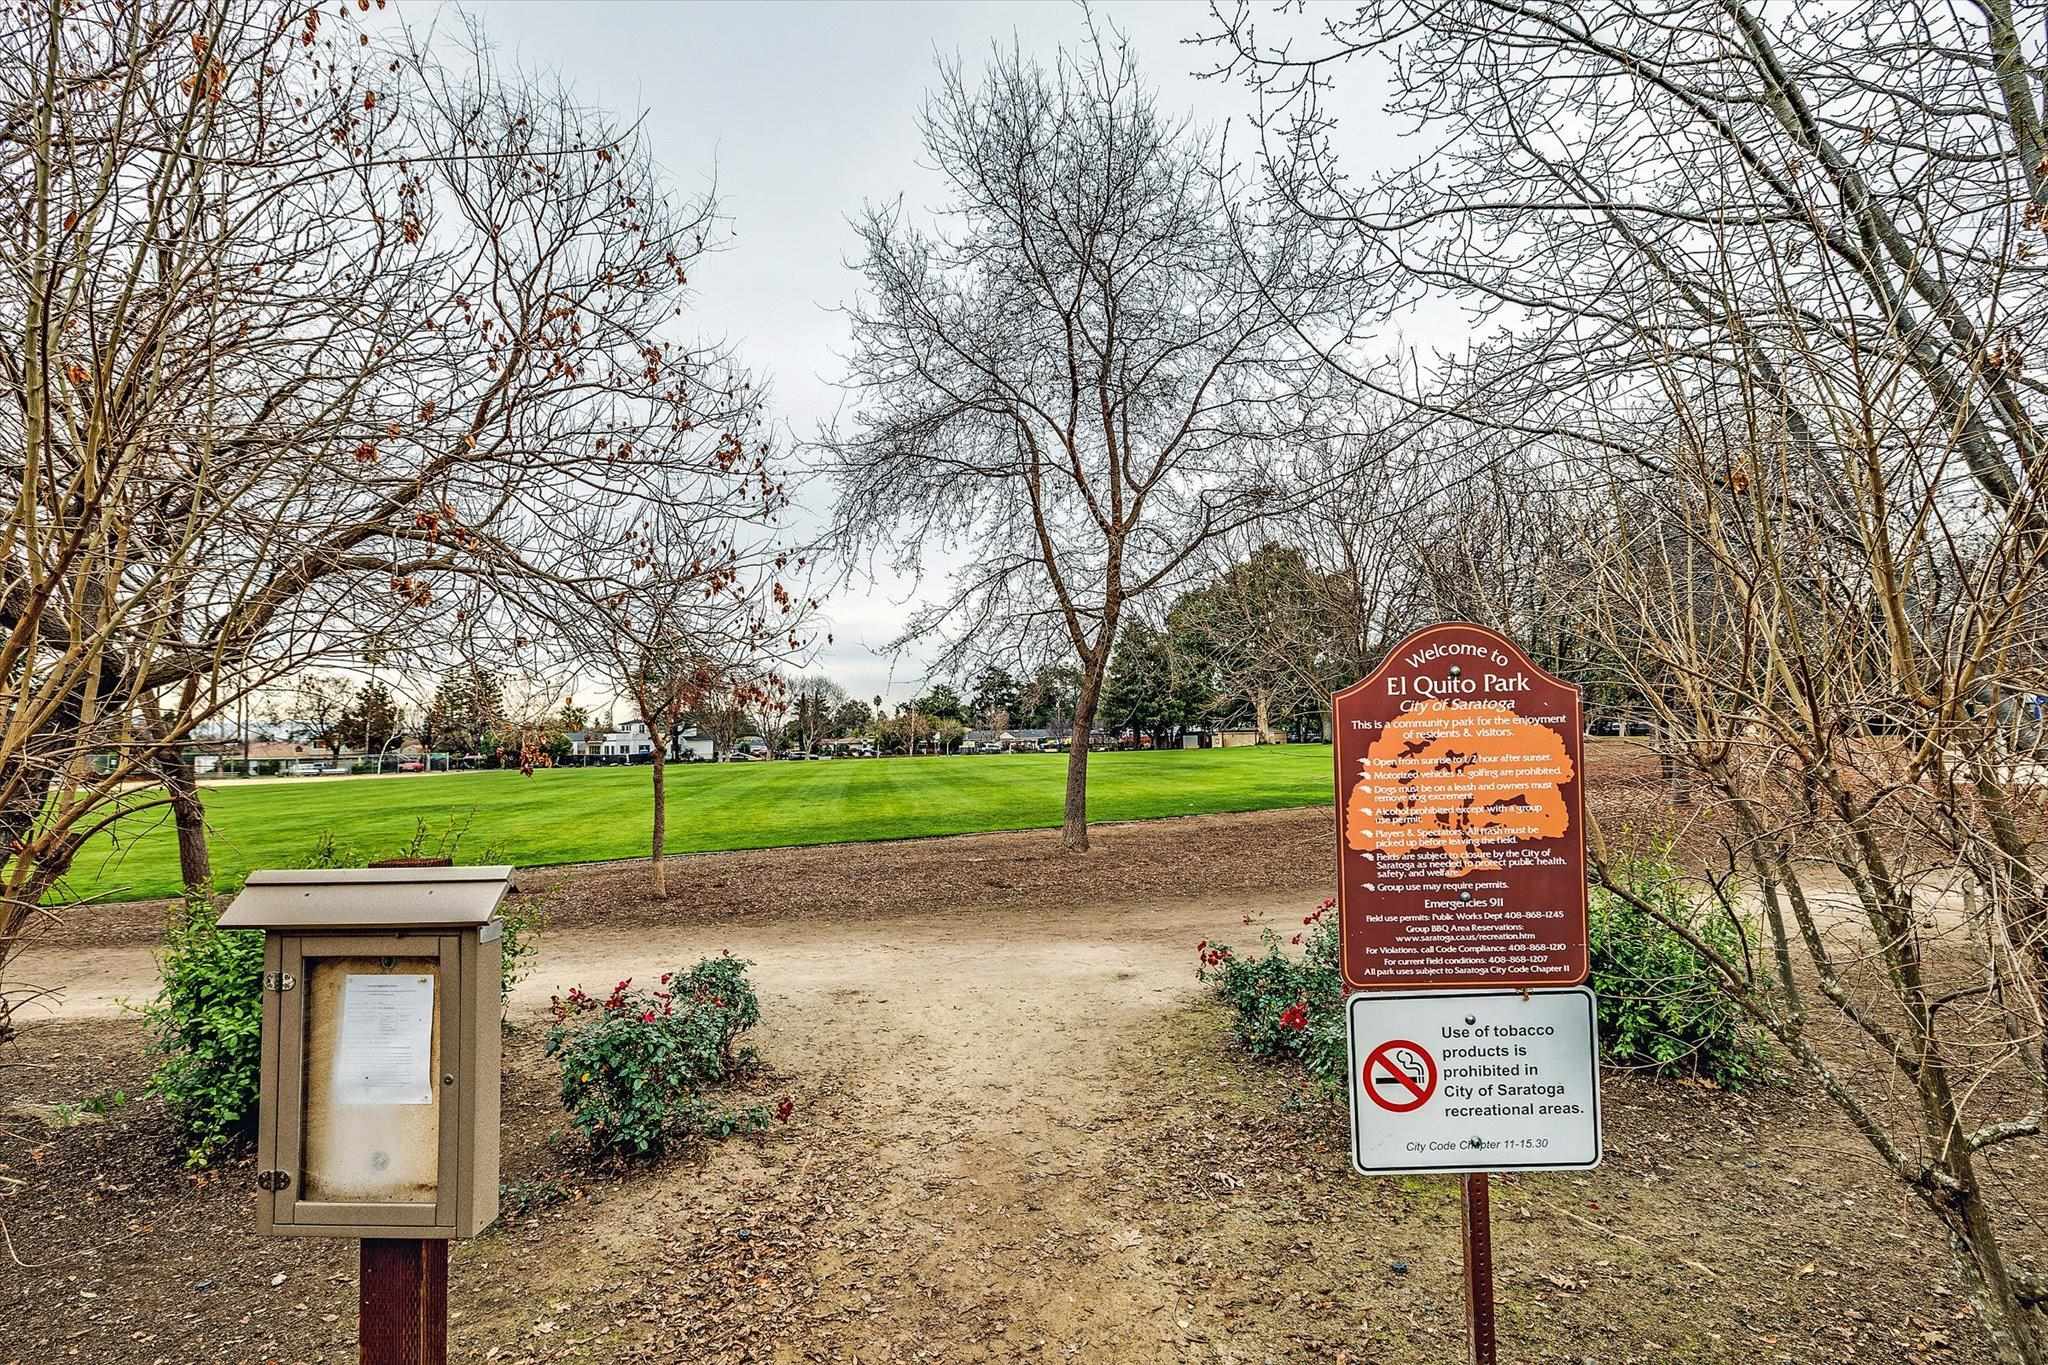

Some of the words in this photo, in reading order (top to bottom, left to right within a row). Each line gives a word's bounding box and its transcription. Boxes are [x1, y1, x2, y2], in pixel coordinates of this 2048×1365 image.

[1405, 643, 1488, 669] Welcome
[1490, 650, 1509, 666] to
[1387, 677, 1406, 696] El
[1414, 677, 1476, 699] Quito
[1484, 673, 1530, 692] Park
[1400, 700, 1426, 713] City
[1432, 699, 1448, 711] of
[1451, 699, 1515, 712] Saratoga
[1352, 721, 1373, 729] This
[1374, 721, 1383, 729] is
[1392, 719, 1450, 730] community
[1452, 719, 1474, 729] park
[1477, 717, 1491, 726] for
[1493, 717, 1510, 726] the
[1513, 715, 1566, 726] enjoyment
[1403, 731, 1414, 740] of
[1416, 729, 1460, 739] residents
[1463, 729, 1471, 738] &
[1373, 758, 1397, 767] Open
[1398, 757, 1420, 765] from
[1422, 757, 1452, 765] sunrise
[1478, 756, 1499, 764] hour
[1500, 755, 1521, 763] after
[1374, 771, 1417, 780] Motorized
[1419, 771, 1455, 779] vehicles
[1457, 770, 1465, 778] &
[1468, 769, 1499, 780] golfing
[1374, 785, 1397, 794] Dogs
[1399, 785, 1418, 793] must
[1420, 784, 1431, 792] be
[1454, 783, 1476, 791] leash
[1478, 782, 1495, 790] and
[1375, 794, 1409, 802] remove
[1410, 793, 1427, 803] dog
[1376, 807, 1408, 815] Alcohol
[1410, 806, 1454, 816] prohibited
[1456, 805, 1485, 815] except
[1518, 805, 1542, 814] group
[1376, 816, 1391, 824] use
[1376, 829, 1405, 839] Players
[1407, 829, 1414, 837] &
[1468, 827, 1479, 835] All
[1480, 826, 1502, 834] trash
[1504, 826, 1525, 834] must
[1376, 838, 1403, 849] picked
[1405, 839, 1417, 847] up
[1419, 836, 1448, 846] before
[1450, 836, 1480, 847] leaving
[1481, 836, 1495, 844] the
[1496, 835, 1517, 843] field.
[1376, 853, 1401, 861] Fields
[1417, 851, 1447, 862] subject
[1460, 850, 1492, 858] closure
[1493, 850, 1504, 860] by
[1506, 849, 1520, 857] the
[1521, 849, 1539, 859] City
[1541, 848, 1551, 857] of
[1376, 861, 1415, 870] Saratoga
[1429, 859, 1462, 868] needed
[1464, 859, 1474, 867] to
[1476, 858, 1506, 868] protect
[1509, 857, 1534, 868] public
[1537, 857, 1567, 865] health.
[1408, 868, 1425, 877] and
[1377, 883, 1404, 893] Group
[1406, 883, 1422, 891] use
[1423, 882, 1441, 892] may
[1443, 881, 1474, 892] require
[1476, 880, 1509, 891] permits.
[1490, 897, 1503, 907] 911
[1397, 914, 1430, 923] permits:
[1432, 913, 1453, 921] Public
[1484, 912, 1502, 922] Dept
[1504, 911, 1564, 919] 408-868-1245
[1406, 925, 1430, 934] Group
[1432, 924, 1449, 934] BBQ
[1451, 924, 1471, 932] Area
[1471, 923, 1524, 931] Reservations:
[1421, 945, 1434, 953] call
[1436, 945, 1457, 953] Code
[1459, 944, 1506, 954] Compliance:
[1508, 943, 1566, 952] 408-868-1210
[1444, 956, 1487, 964] conditions:
[1488, 955, 1548, 963] 408-868-1207
[1377, 968, 1394, 977] park
[1416, 967, 1443, 976] subject
[1454, 966, 1489, 975] Saratoga
[1491, 966, 1507, 975] City
[1530, 964, 1562, 974] Chapter
[1442, 1026, 1469, 1038] Use
[1475, 1025, 1489, 1037] of
[1494, 1024, 1554, 1037] tobacco
[1442, 1045, 1509, 1061] products
[1514, 1044, 1527, 1056] is
[1444, 1064, 1519, 1080] prohibited
[1525, 1064, 1538, 1075] in
[1445, 1085, 1473, 1101] City
[1479, 1085, 1493, 1096] of
[1497, 1083, 1564, 1097] Saratoga
[1446, 1104, 1533, 1117] recreational
[1539, 1105, 1583, 1115] areas.
[1407, 1141, 1426, 1153] City
[1430, 1140, 1456, 1151] Code
[1459, 1139, 1500, 1151] Chpter
[1504, 1138, 1548, 1149] 11-15.30
